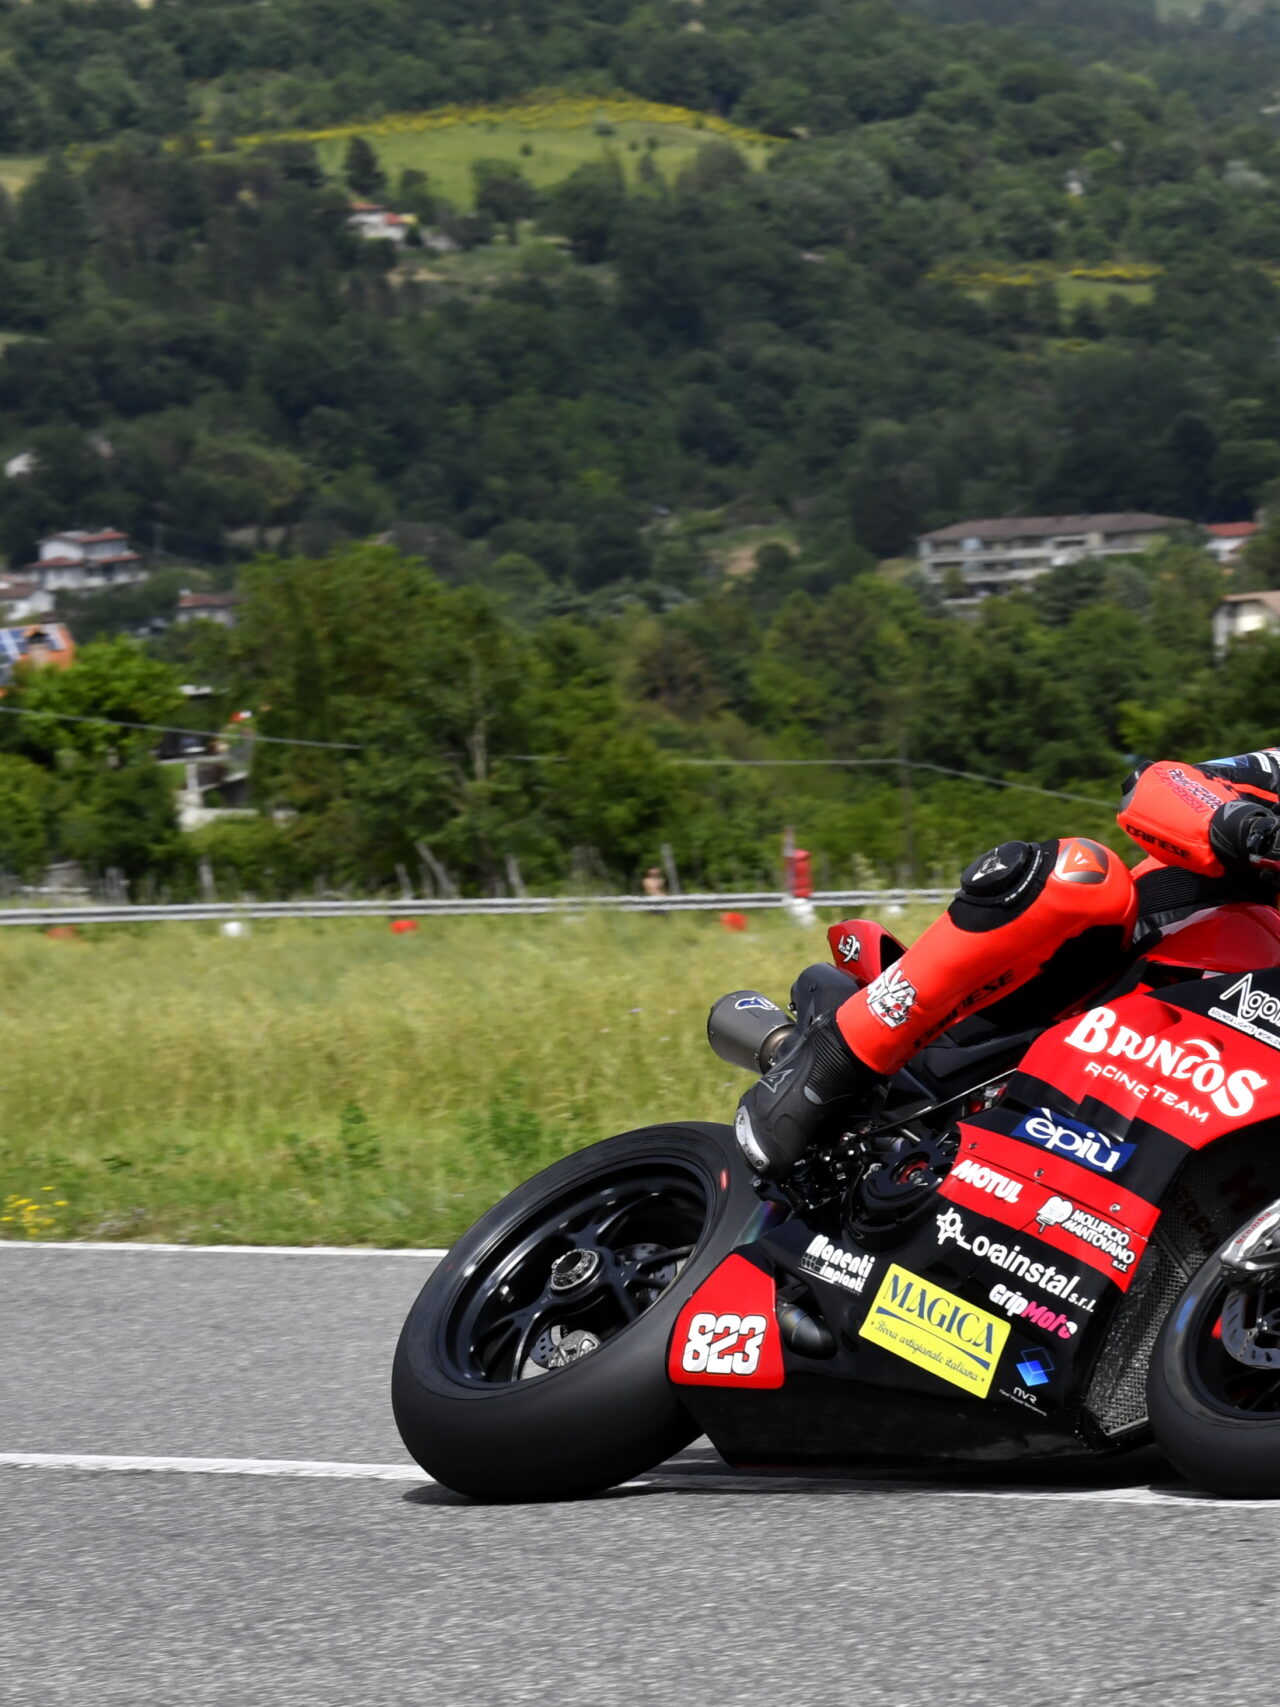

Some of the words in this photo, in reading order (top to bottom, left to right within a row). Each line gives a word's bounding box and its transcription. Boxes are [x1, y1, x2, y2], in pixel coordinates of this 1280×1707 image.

[1152, 1084, 1211, 1123] TEAM
[950, 1159, 1024, 1204] MOTUL
[1061, 1218, 1136, 1265] MANTOVANO
[1235, 1211, 1273, 1245] brembo
[805, 1234, 876, 1278] Manenti
[882, 1273, 994, 1355] MAGICA
[681, 1312, 768, 1376] 823
[875, 1319, 898, 1340] Birra
[898, 1335, 945, 1364] artigianale
[944, 1356, 979, 1382] italiana
